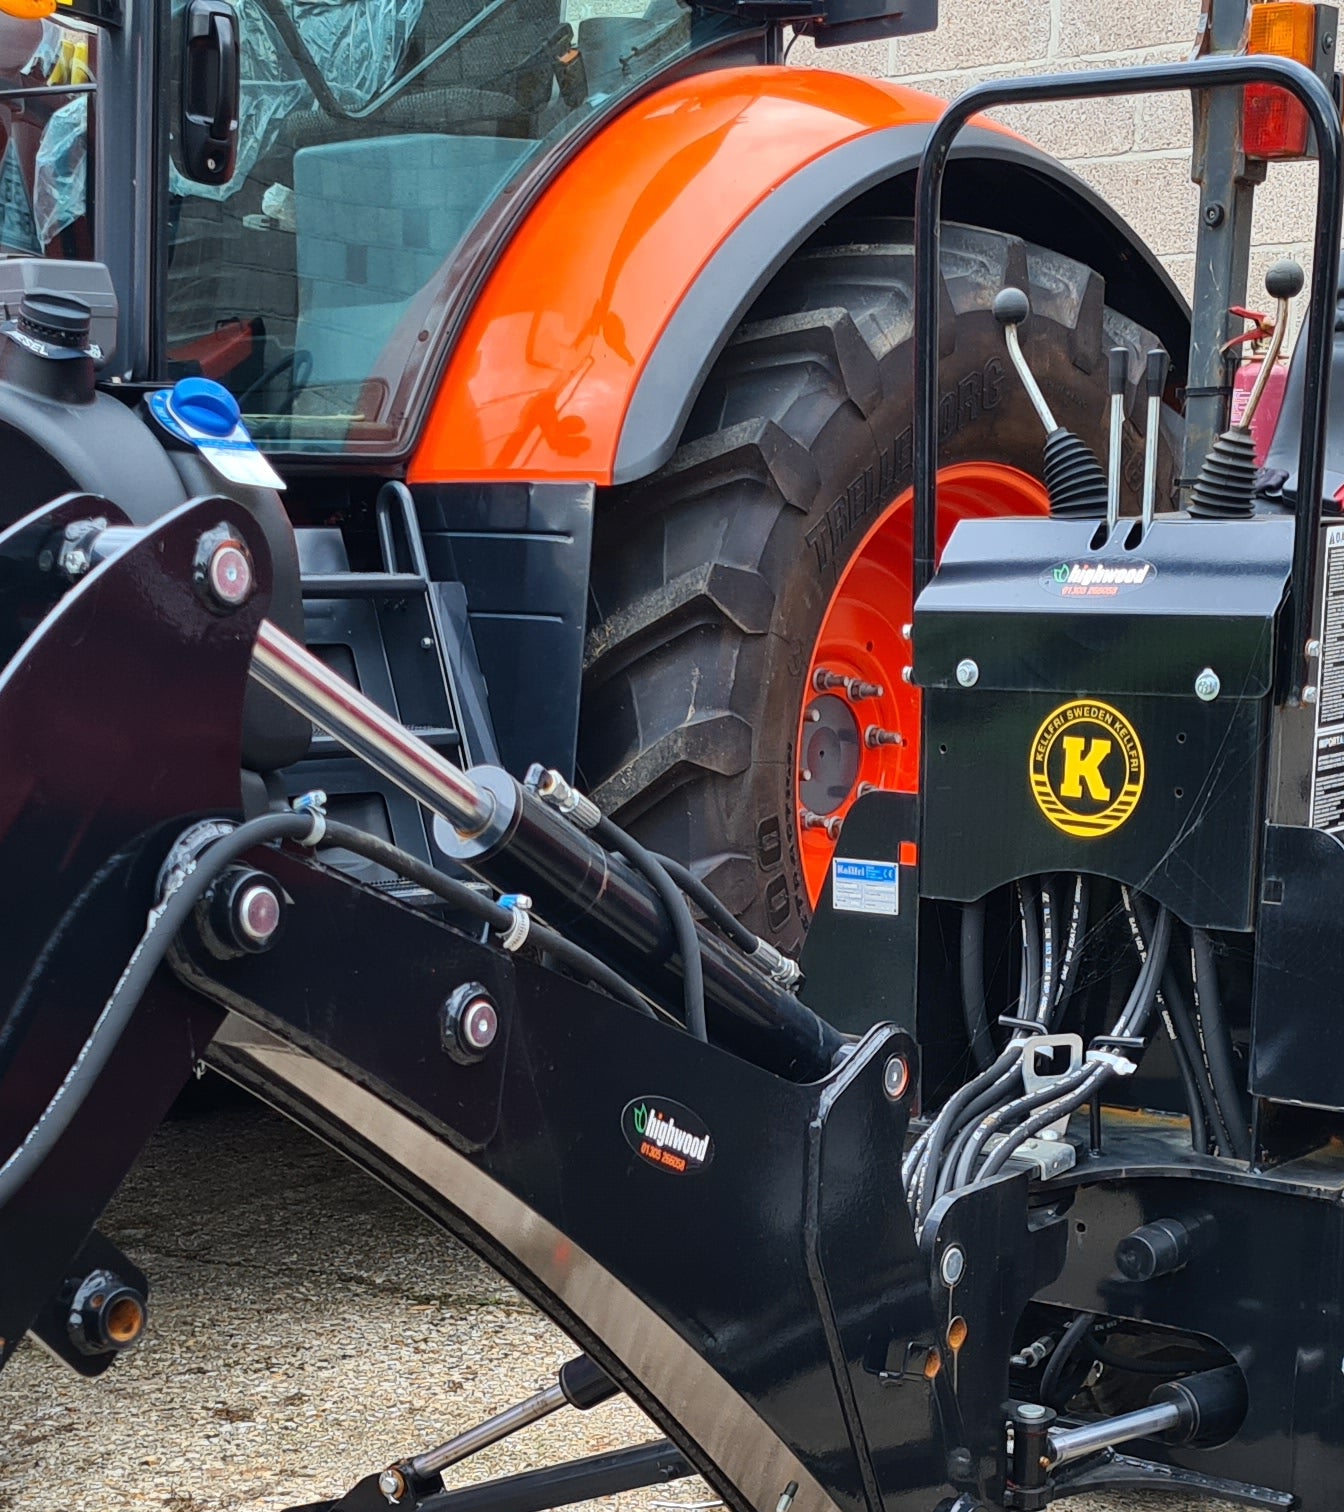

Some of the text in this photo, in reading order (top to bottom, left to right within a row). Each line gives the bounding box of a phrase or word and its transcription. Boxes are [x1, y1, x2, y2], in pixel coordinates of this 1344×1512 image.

[802, 354, 1006, 573] TRELLEORG
[1067, 563, 1150, 586] highwood
[1035, 707, 1139, 772] KELLFRI SWEDEN KELLFRI
[1060, 736, 1112, 801] K
[645, 1108, 710, 1162] highwood
